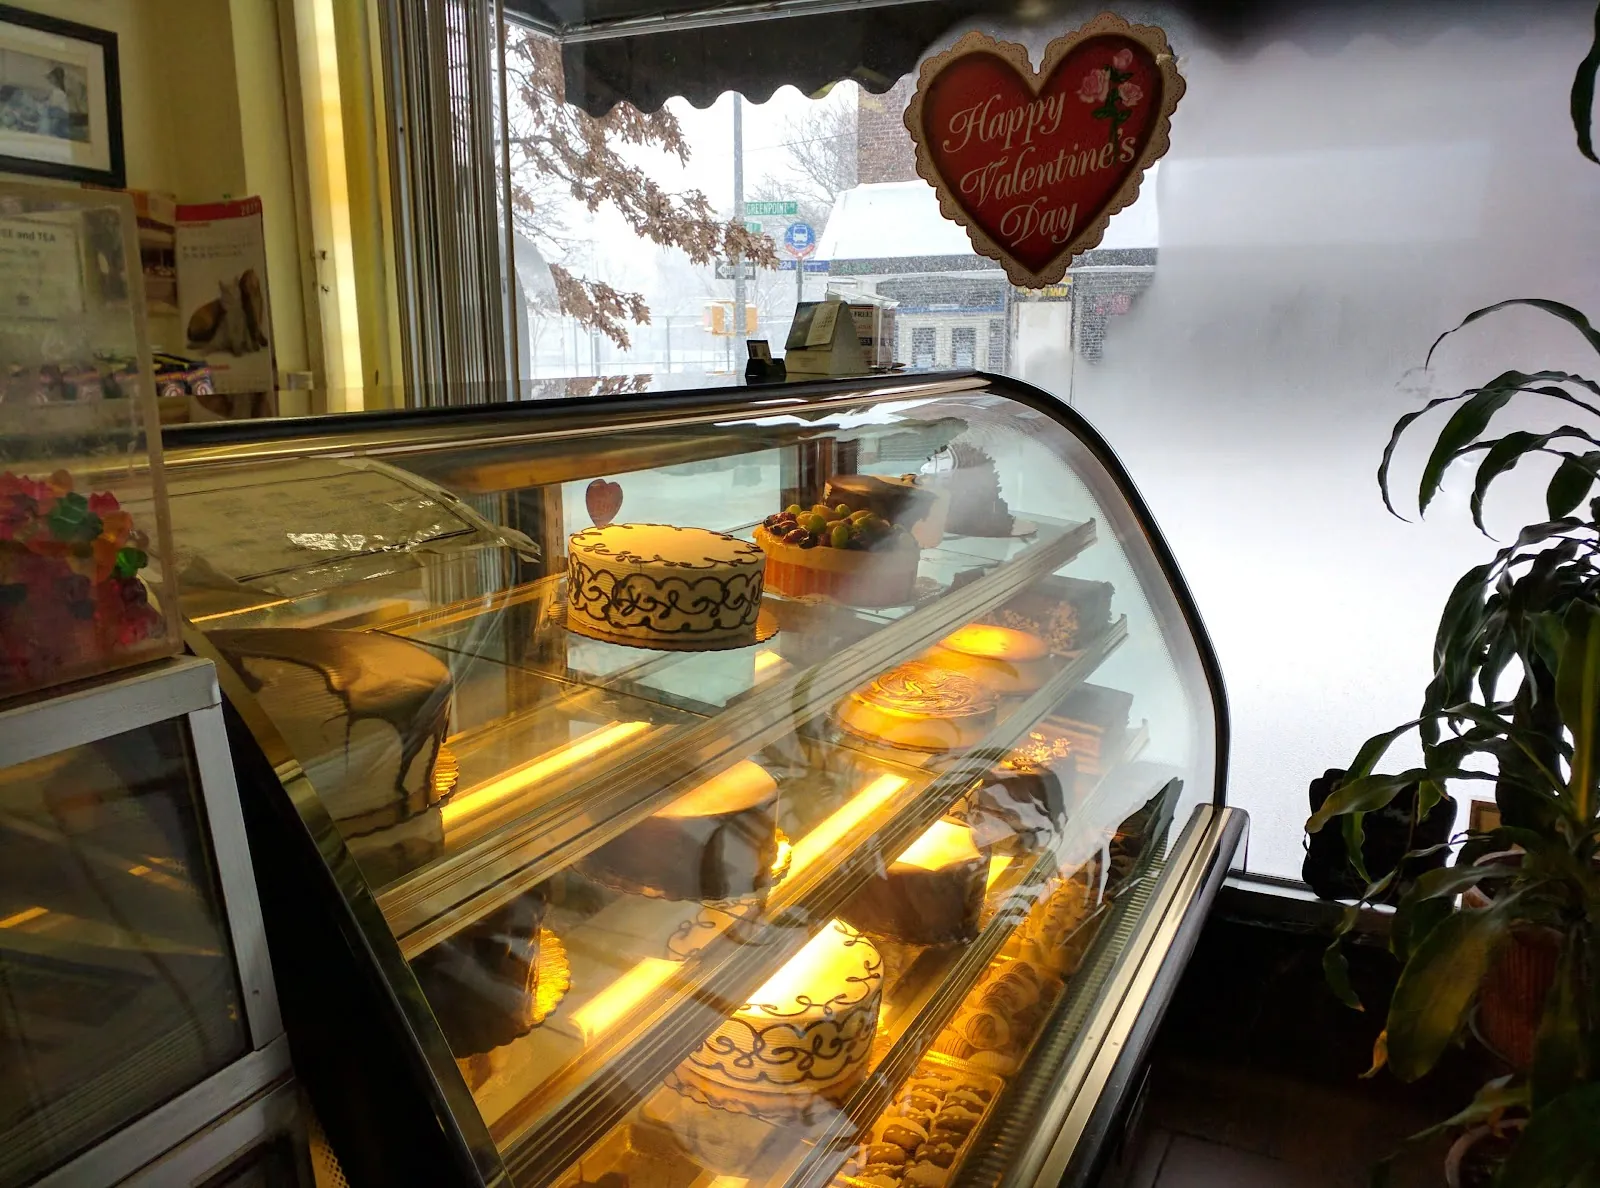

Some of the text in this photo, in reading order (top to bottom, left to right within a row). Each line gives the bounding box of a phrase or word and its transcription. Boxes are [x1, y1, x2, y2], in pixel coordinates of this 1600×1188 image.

[943, 92, 1065, 153] Happy
[960, 128, 1136, 207] Valentine's
[746, 202, 788, 215] GREENPOINT
[1000, 196, 1078, 247] Day
[17, 231, 35, 240] and
[38, 232, 56, 242] TEA
